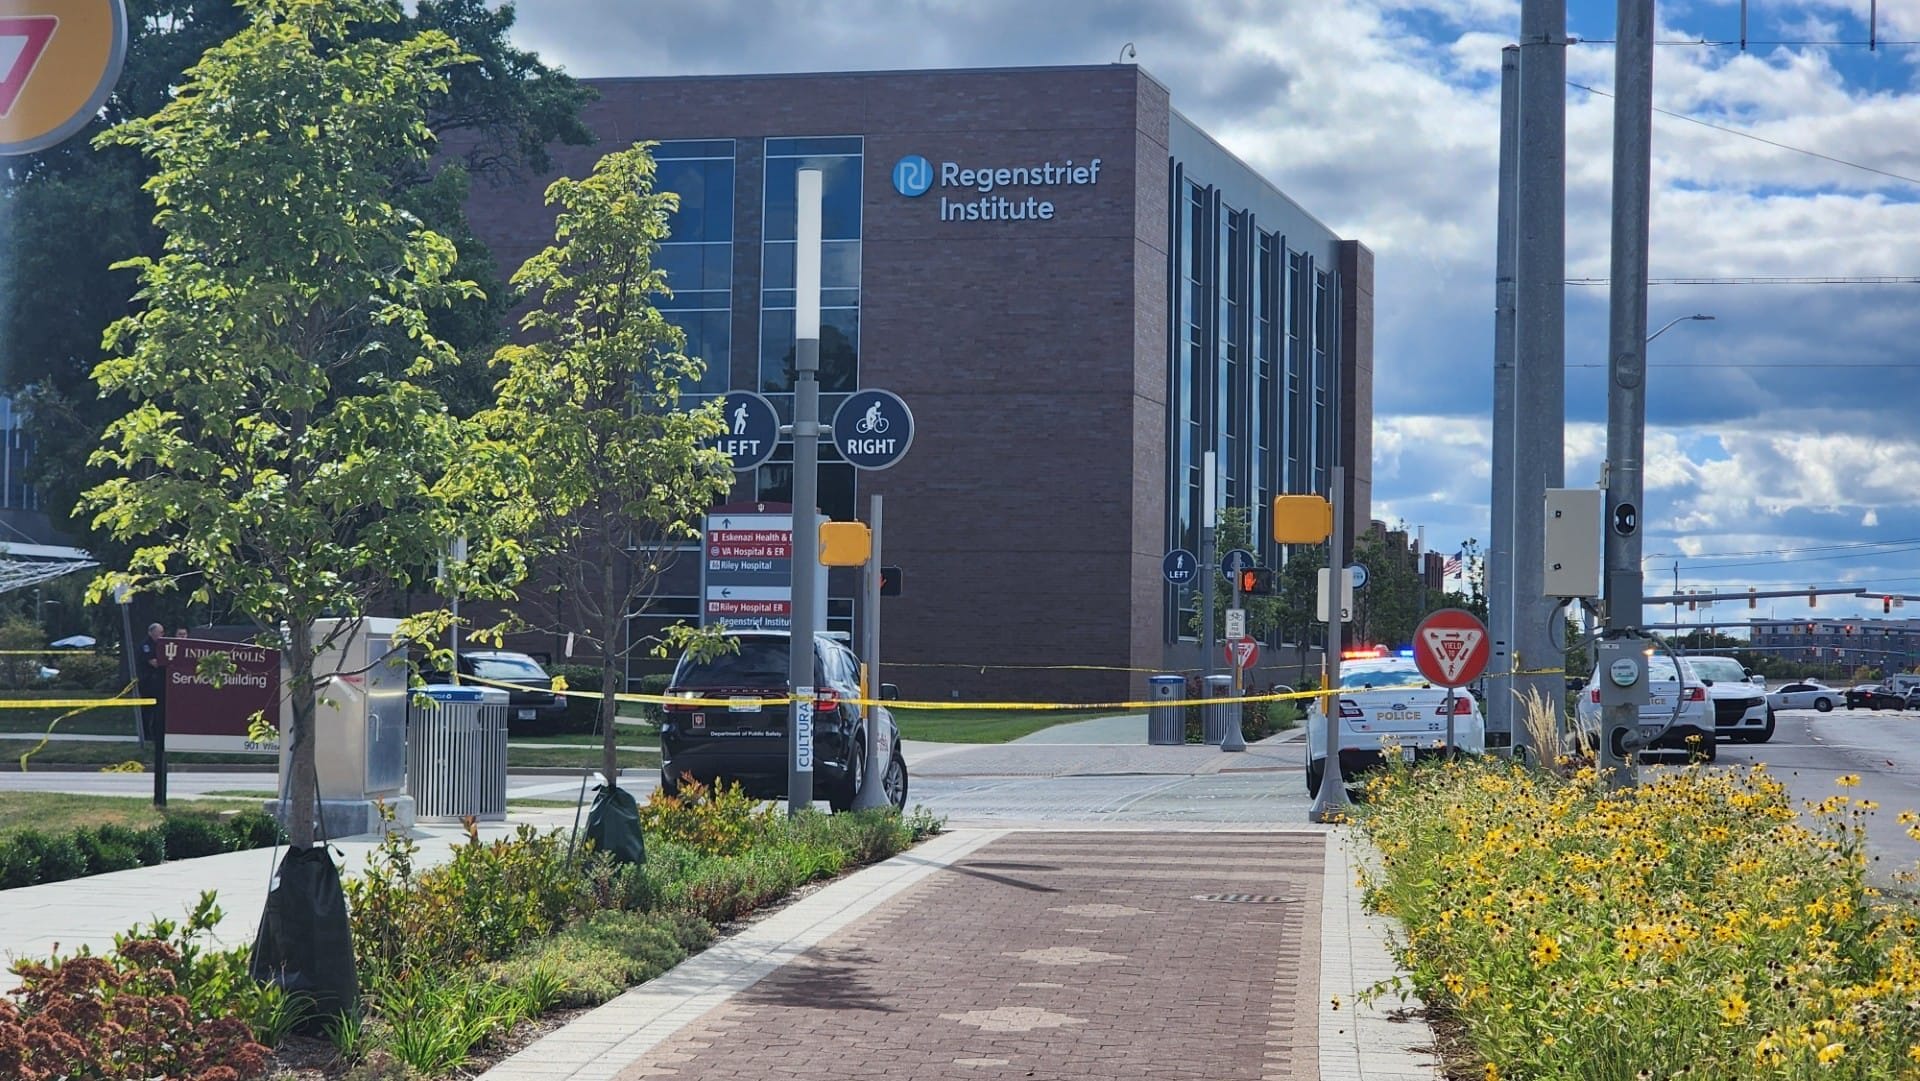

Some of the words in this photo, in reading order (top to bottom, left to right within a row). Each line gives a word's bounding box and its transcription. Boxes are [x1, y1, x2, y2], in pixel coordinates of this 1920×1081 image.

[941, 159, 1101, 192] Regenstrief
[940, 196, 1055, 221] Institute
[717, 440, 760, 456] LEFT
[847, 439, 896, 455] RIGHT
[722, 533, 753, 542] Eskenazi
[755, 533, 780, 542] Health
[722, 547, 732, 555] VA
[734, 546, 764, 557] Hospital
[766, 547, 773, 555] &
[774, 547, 784, 555] ER
[721, 561, 739, 571] Riley
[741, 561, 772, 571] Hospital
[720, 602, 739, 613] Riley
[740, 602, 771, 613] Hospital
[773, 603, 783, 612] ER
[1443, 642, 1462, 650] YIELD
[184, 648, 266, 663] INDIPOLIS
[1376, 711, 1422, 721] POLICE
[799, 702, 810, 768] CULTURA
[244, 741, 259, 750] 901
